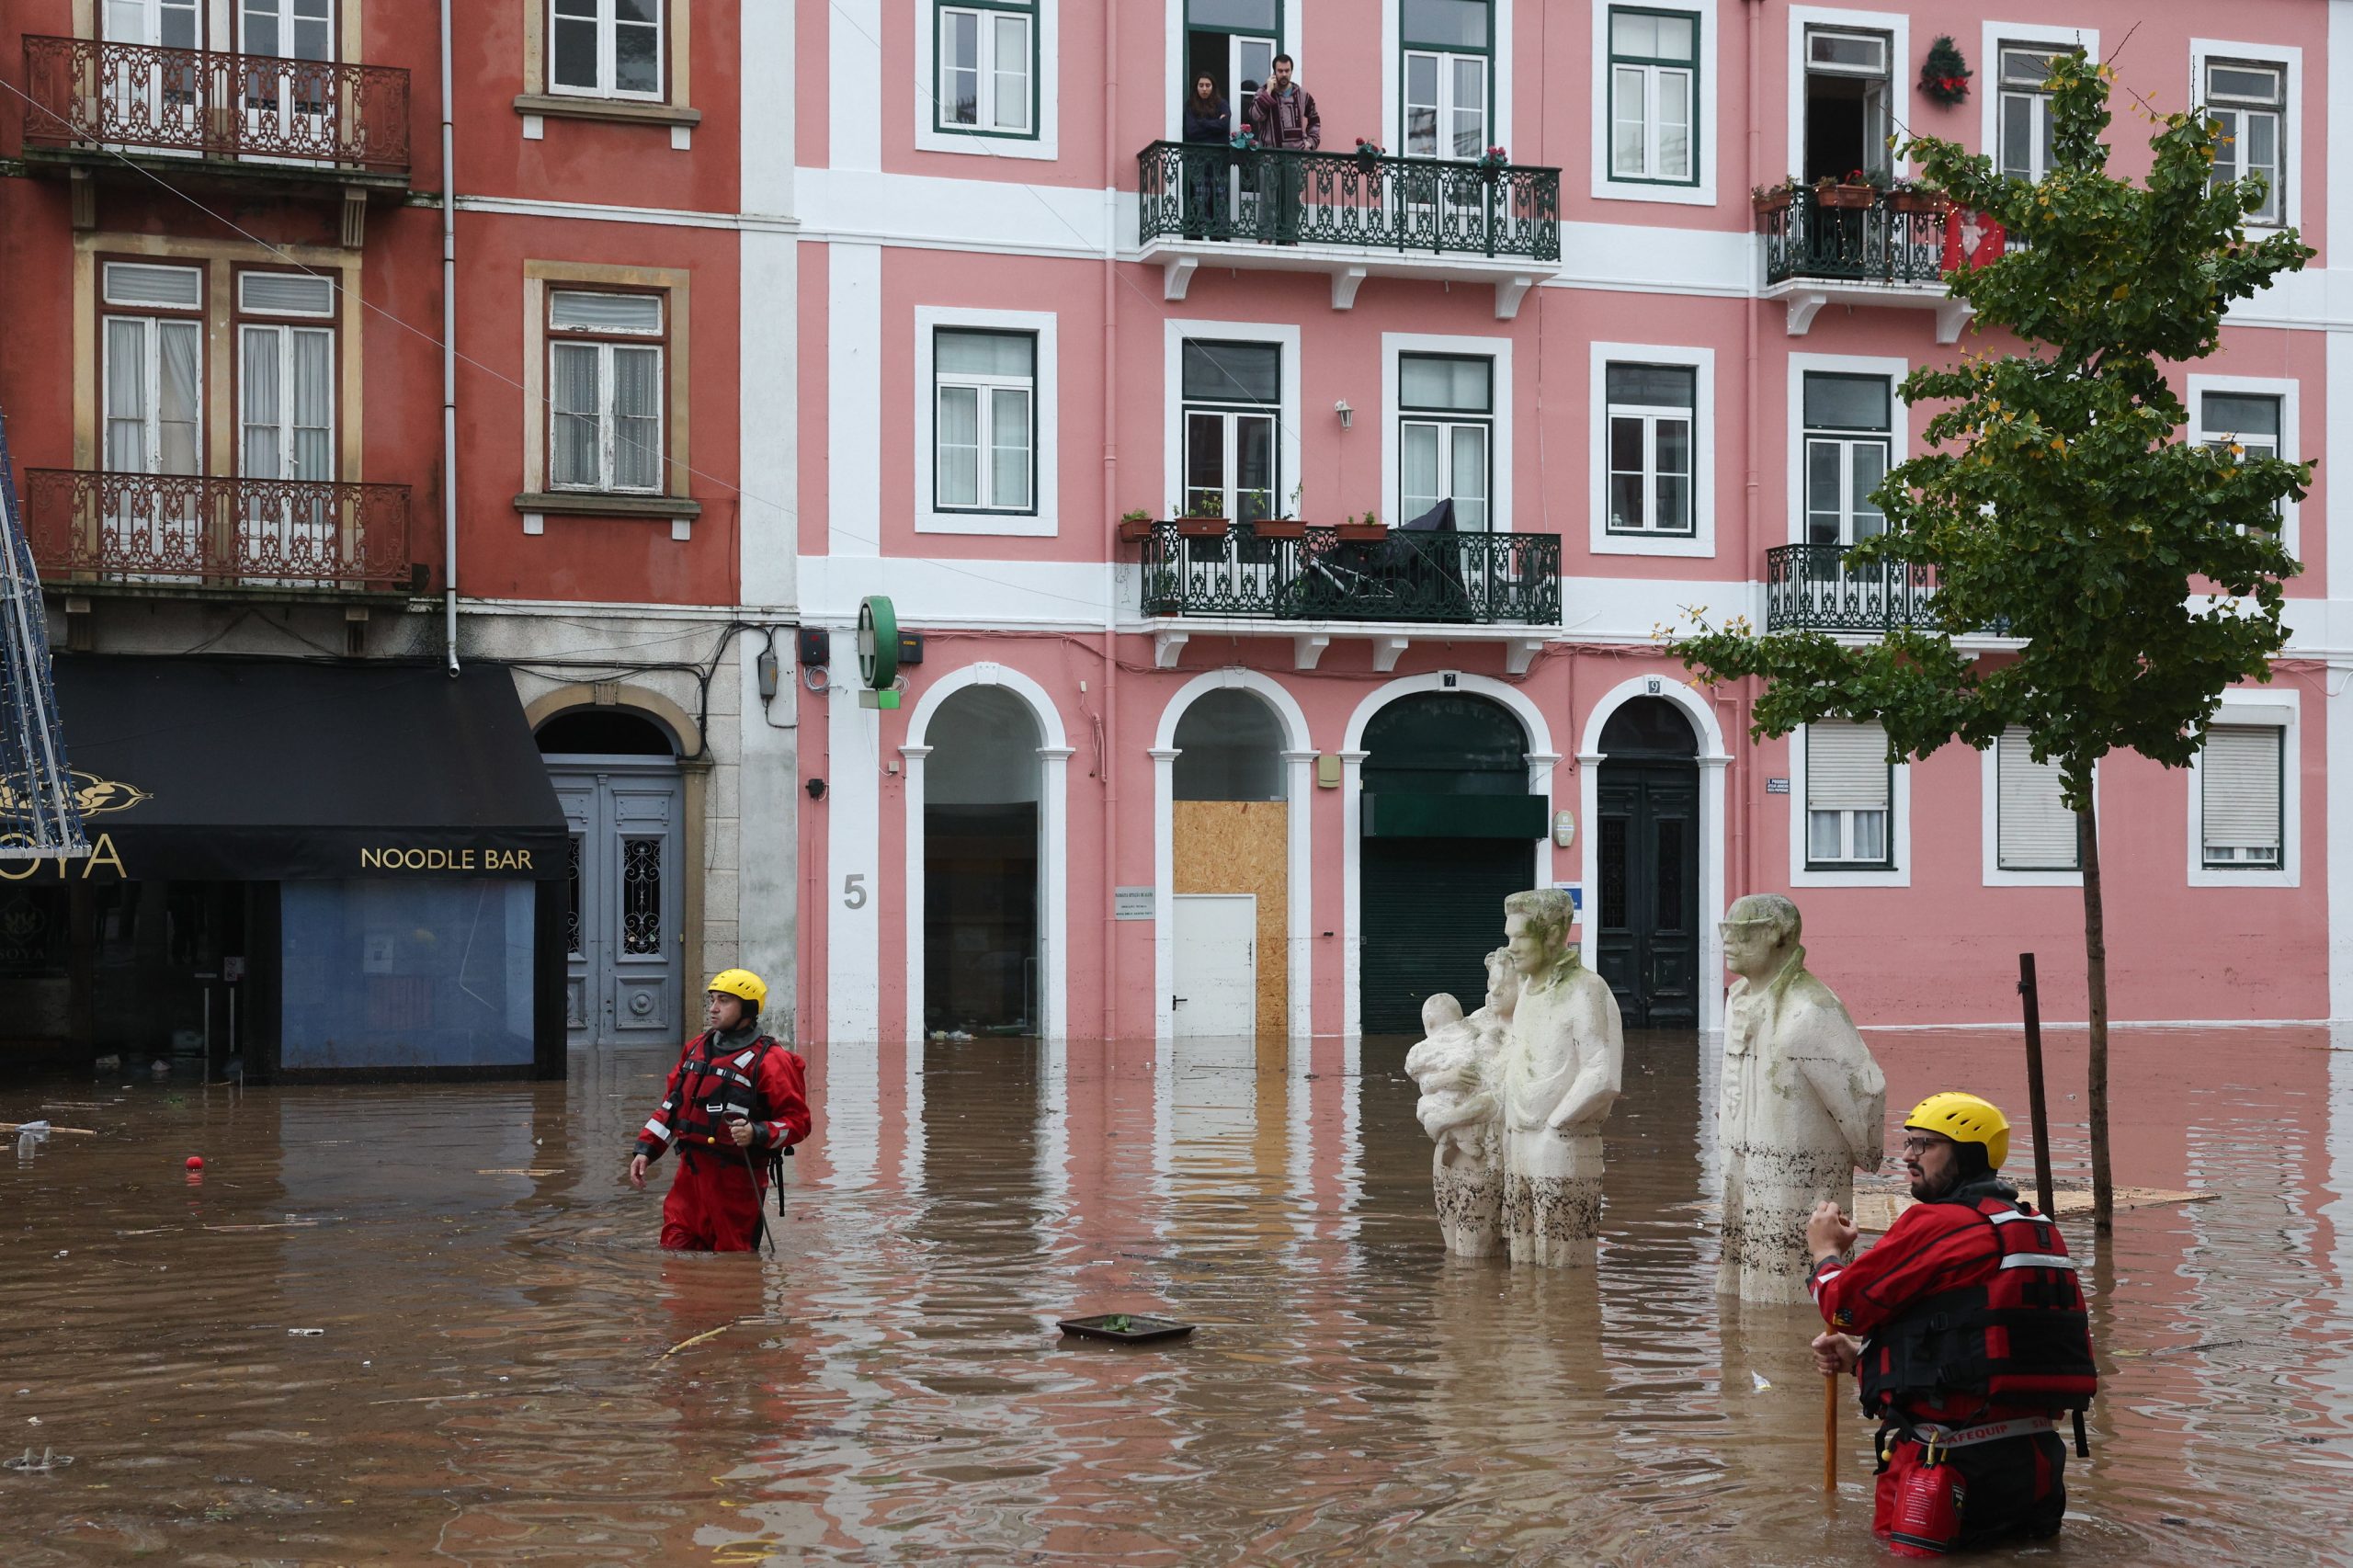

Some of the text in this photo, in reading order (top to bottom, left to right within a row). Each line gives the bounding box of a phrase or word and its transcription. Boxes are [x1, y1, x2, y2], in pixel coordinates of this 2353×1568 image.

[361, 847, 534, 869] NOODLE BAR
[844, 873, 868, 910] 5
[1945, 1425, 2008, 1445] AFEQUIP
